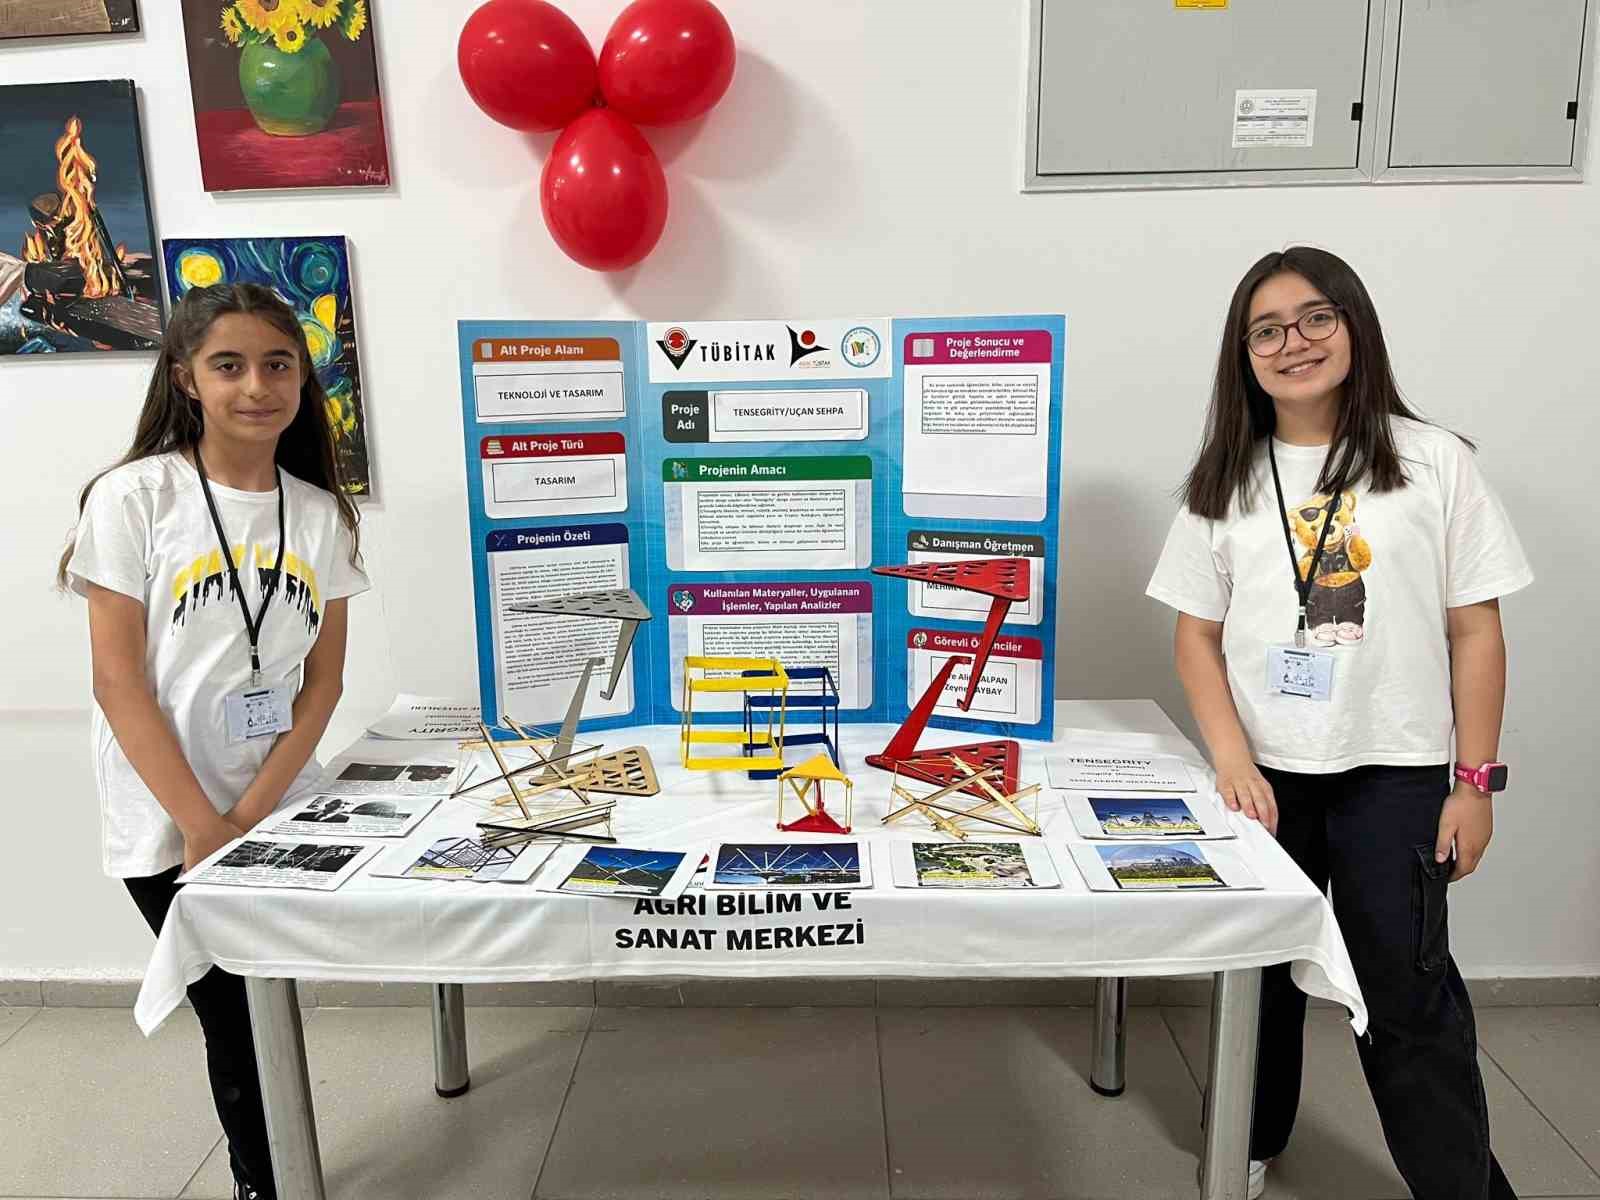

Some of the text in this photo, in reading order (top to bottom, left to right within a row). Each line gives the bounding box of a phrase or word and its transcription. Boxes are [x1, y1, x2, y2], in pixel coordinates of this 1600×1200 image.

[946, 337, 1025, 349] Proje Sonucu ve
[500, 344, 584, 358] Alt Proje Alanı
[699, 340, 776, 363] TÜBİTAK
[950, 347, 1020, 360] Değerlendirme
[498, 388, 604, 400] TEKNOLOJİ VE TASARIM
[671, 404, 700, 418] Proje
[733, 406, 844, 418] TENSEGRİTY/UÇAN SEHPA
[677, 419, 695, 430] Adı
[512, 438, 584, 453] Alt Proje Türü
[698, 464, 787, 478] Projenin Amacı
[535, 475, 576, 486] TASARIM
[517, 530, 591, 546] Projenin Özeti
[932, 538, 1034, 552] Danışman Öğretmen
[703, 588, 860, 600] Kullanılan Materyaller, Uygulanan
[722, 600, 841, 613] İşlemler, Yapılan Analizler
[934, 636, 969, 648] Görevli
[717, 891, 801, 915] BİLİM
[812, 891, 852, 910] VE
[614, 918, 864, 951] SANAT MERKEZİ
